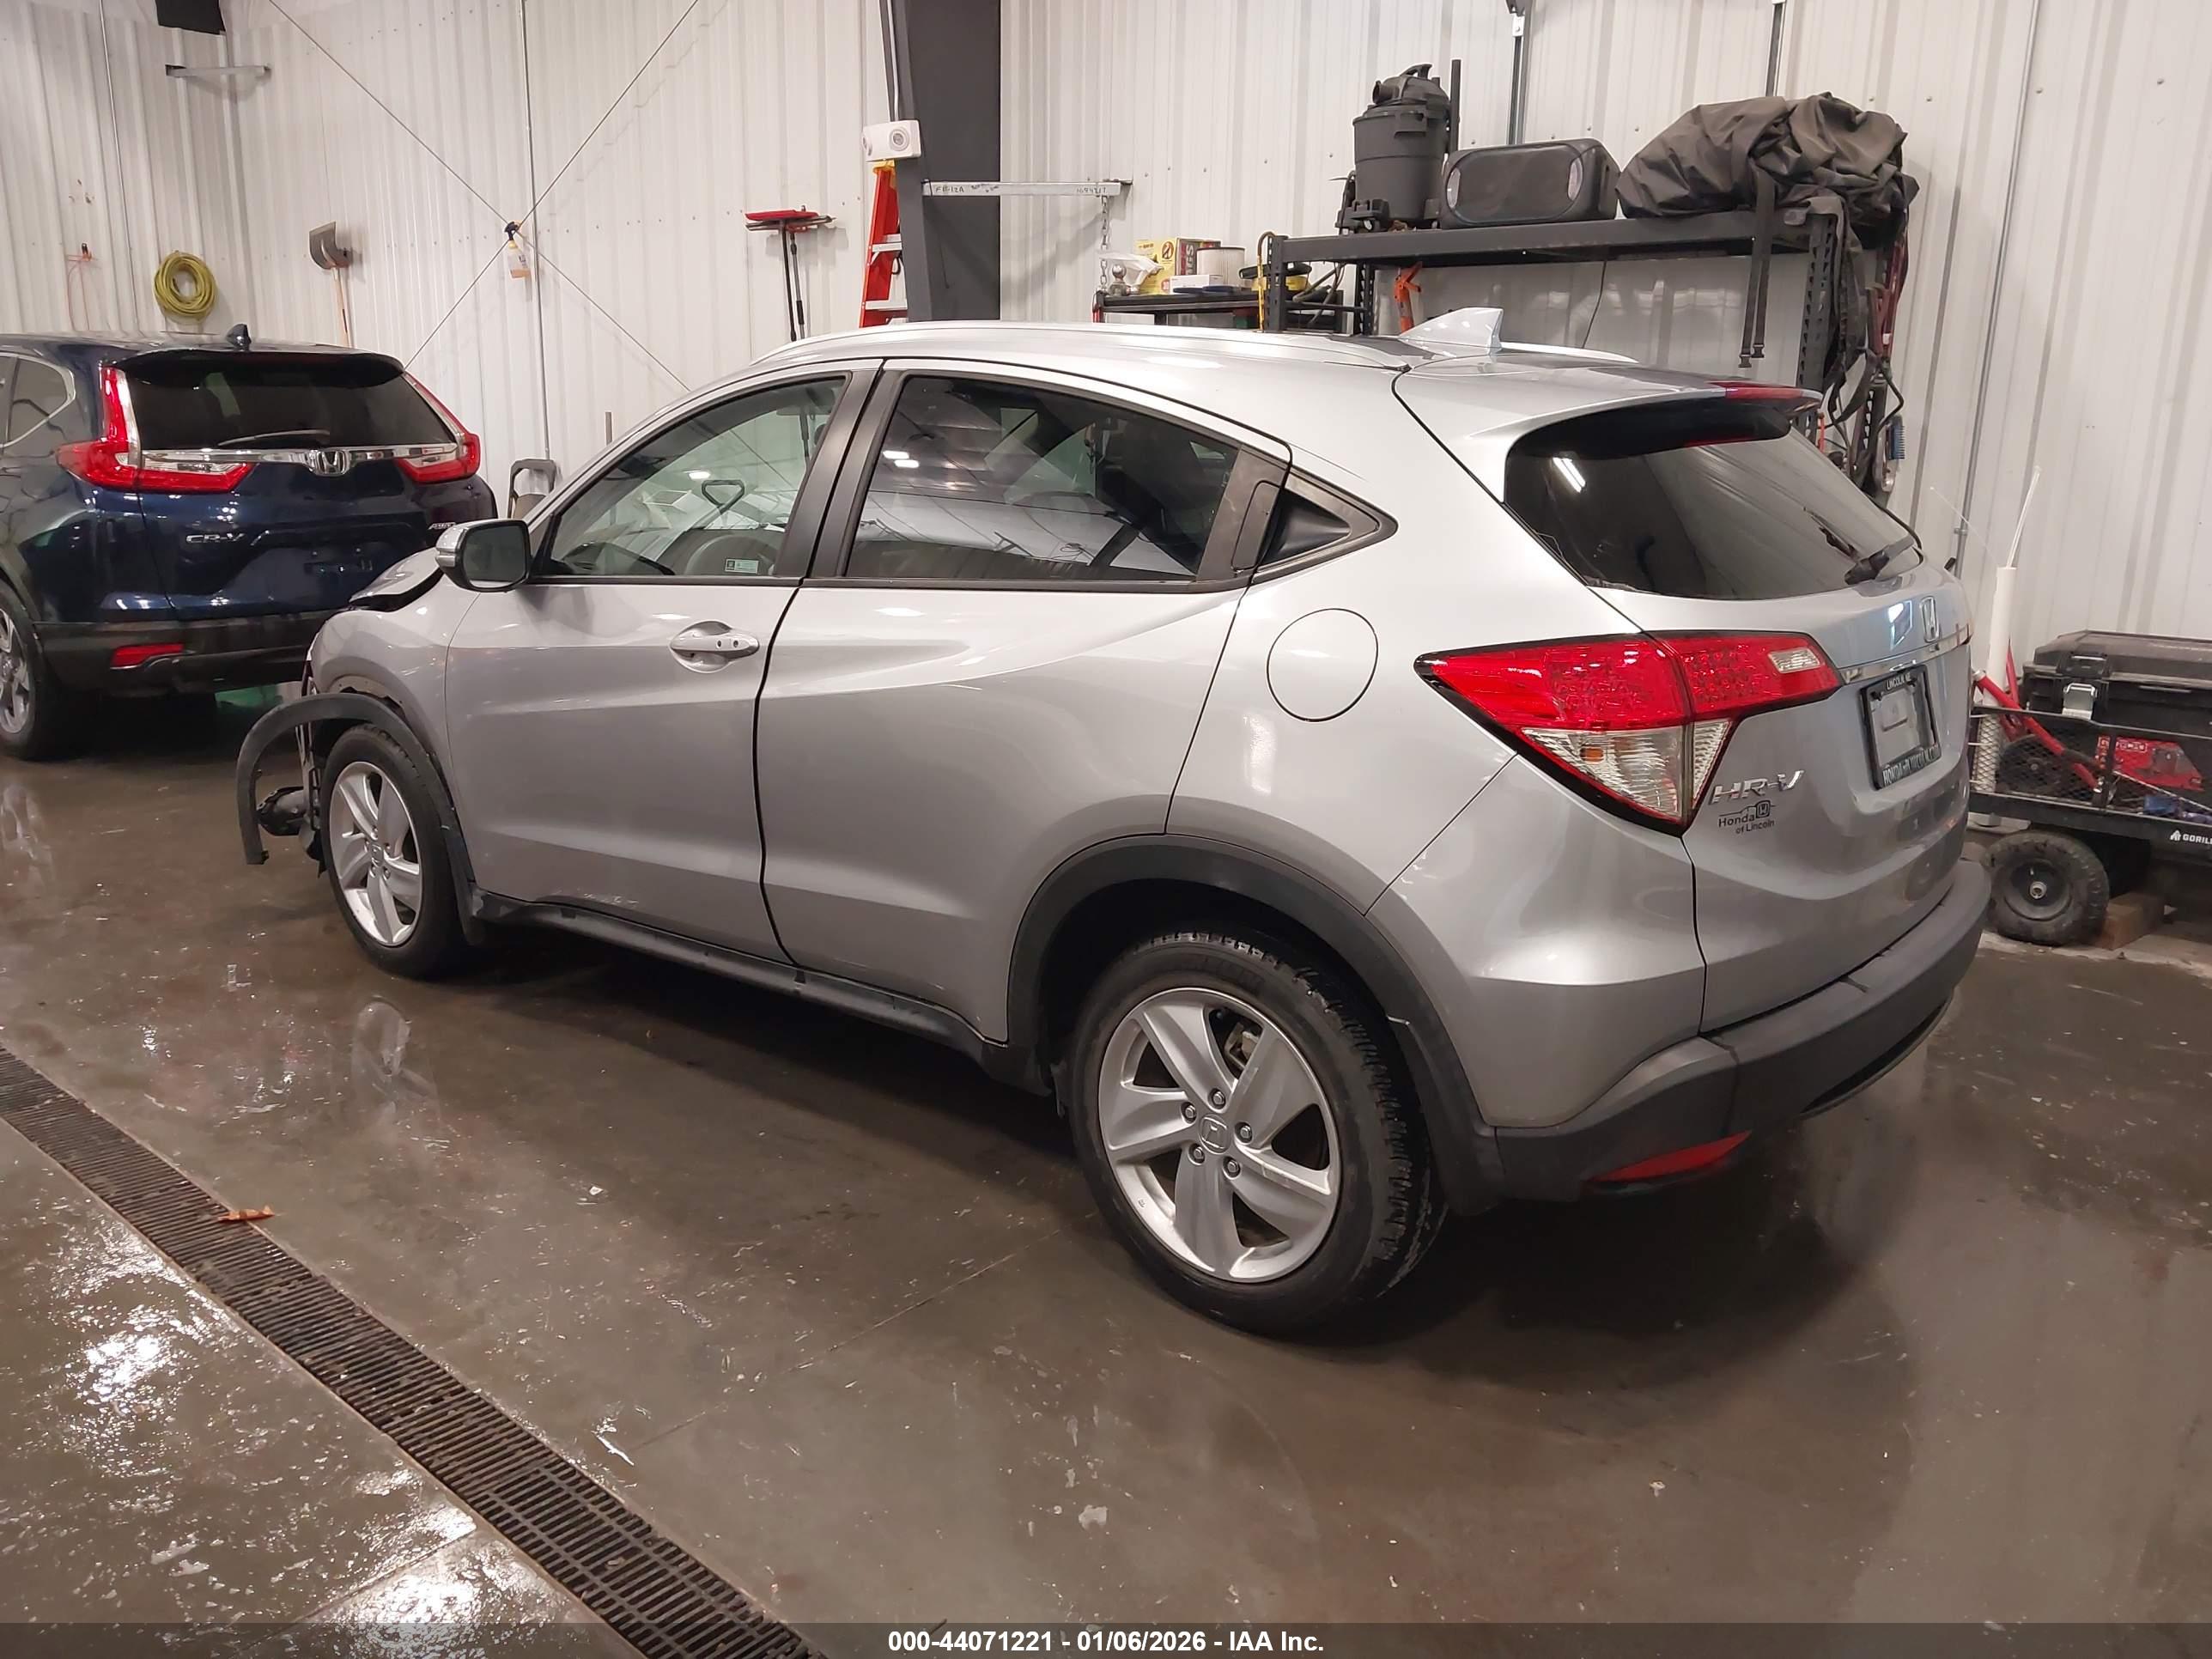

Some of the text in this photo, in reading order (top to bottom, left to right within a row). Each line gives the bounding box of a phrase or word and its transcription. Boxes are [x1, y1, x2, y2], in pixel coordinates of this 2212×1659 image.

[186, 532, 244, 543] CR-V
[1710, 769, 1805, 804] HR-V
[1718, 813, 1755, 827] Honda
[1746, 818, 1775, 831] Lincoln
